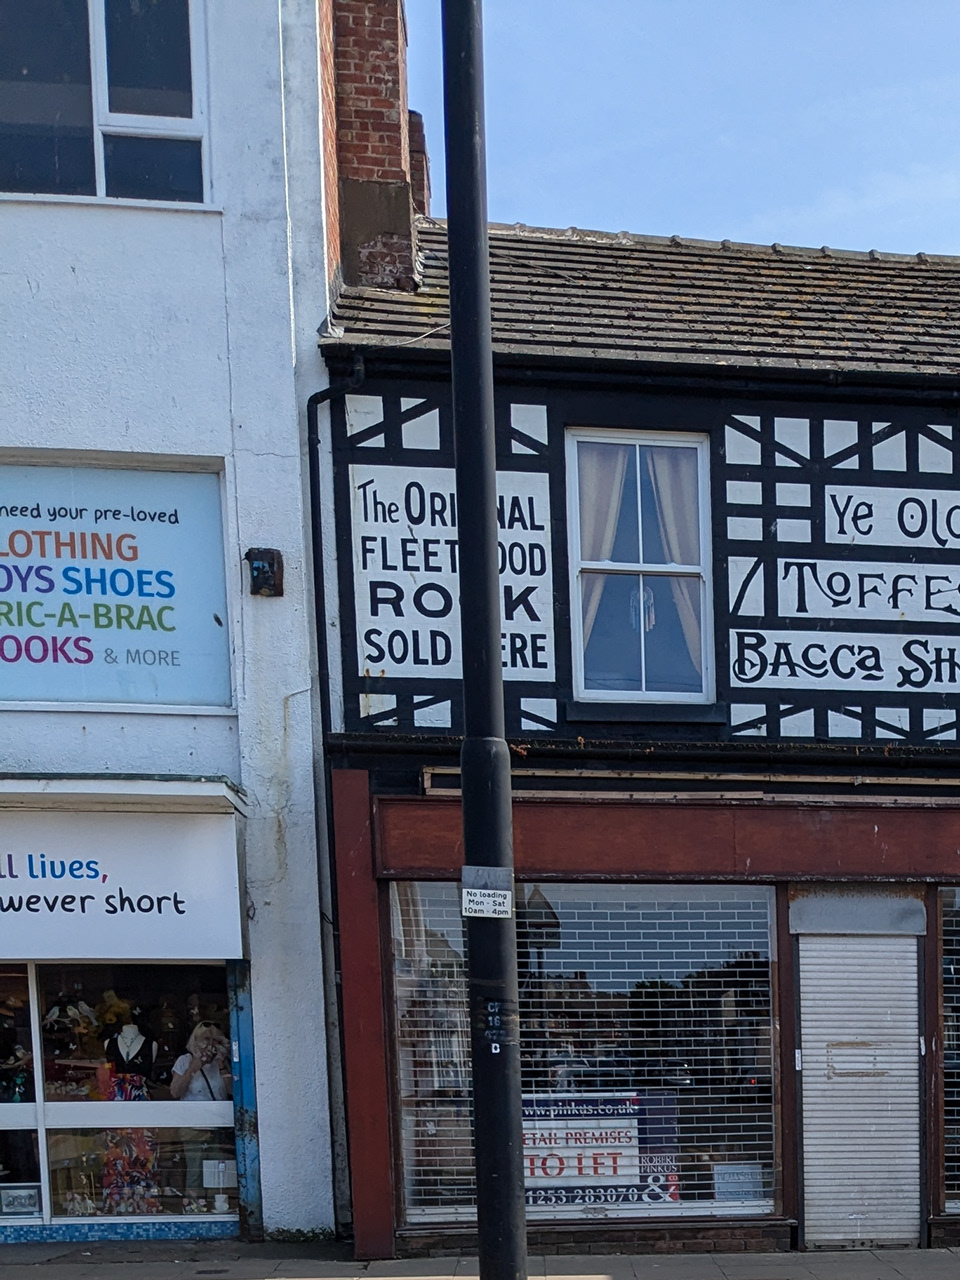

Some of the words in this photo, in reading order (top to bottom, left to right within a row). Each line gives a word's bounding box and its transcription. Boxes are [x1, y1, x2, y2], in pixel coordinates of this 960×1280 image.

[0, 503, 42, 519] need
[47, 505, 88, 522] your
[94, 506, 180, 525] pre-loved
[357, 478, 400, 523] The
[405, 481, 545, 531] ORINAL
[829, 494, 874, 536] Ye
[361, 536, 546, 576] FLEETOD
[62, 566, 176, 599] SHOES
[369, 580, 542, 622] ROK
[0, 634, 94, 664] OOKS
[104, 648, 119, 664] &
[126, 648, 181, 667] MORE
[363, 628, 452, 666] SOLD
[28, 853, 108, 883] lives,
[0, 894, 95, 914] wever
[105, 886, 186, 915] short
[479, 891, 507, 900] loading
[492, 908, 509, 916] 4pm
[523, 1101, 635, 1118] ww.pinkus.co.uk
[522, 1132, 561, 1146] ETAIL
[565, 1130, 633, 1145] PREMISES
[523, 1153, 566, 1177] TO
[576, 1152, 623, 1176] LET
[641, 1155, 678, 1165] ROBERT
[641, 1165, 678, 1173] PINKUS
[526, 1189, 567, 1204] 1253
[574, 1188, 638, 1204] 283070
